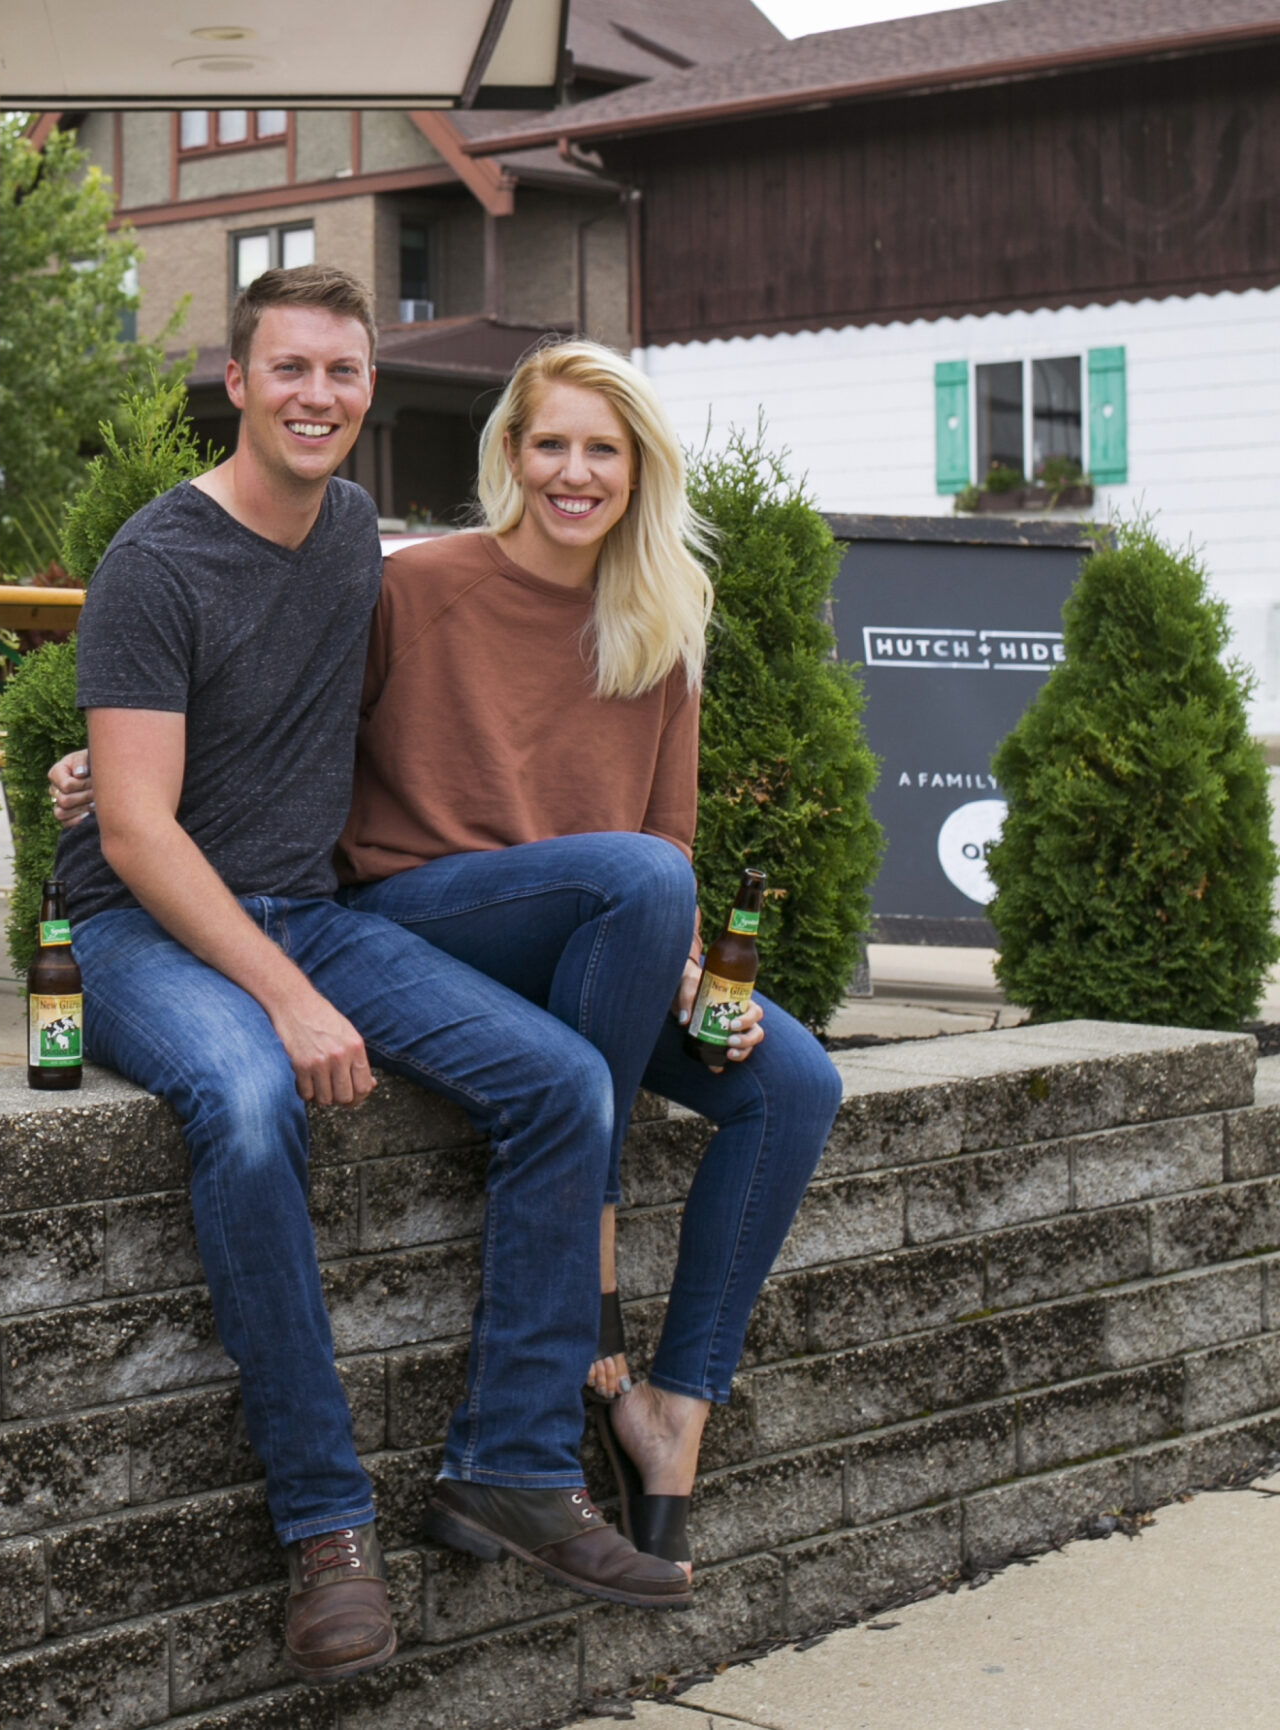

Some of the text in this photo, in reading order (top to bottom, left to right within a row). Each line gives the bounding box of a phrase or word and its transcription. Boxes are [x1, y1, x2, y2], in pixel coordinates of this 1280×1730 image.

[876, 638, 970, 658] HUTCH
[1000, 642, 1067, 661] HIDE
[898, 771, 998, 790] A FAMILY
